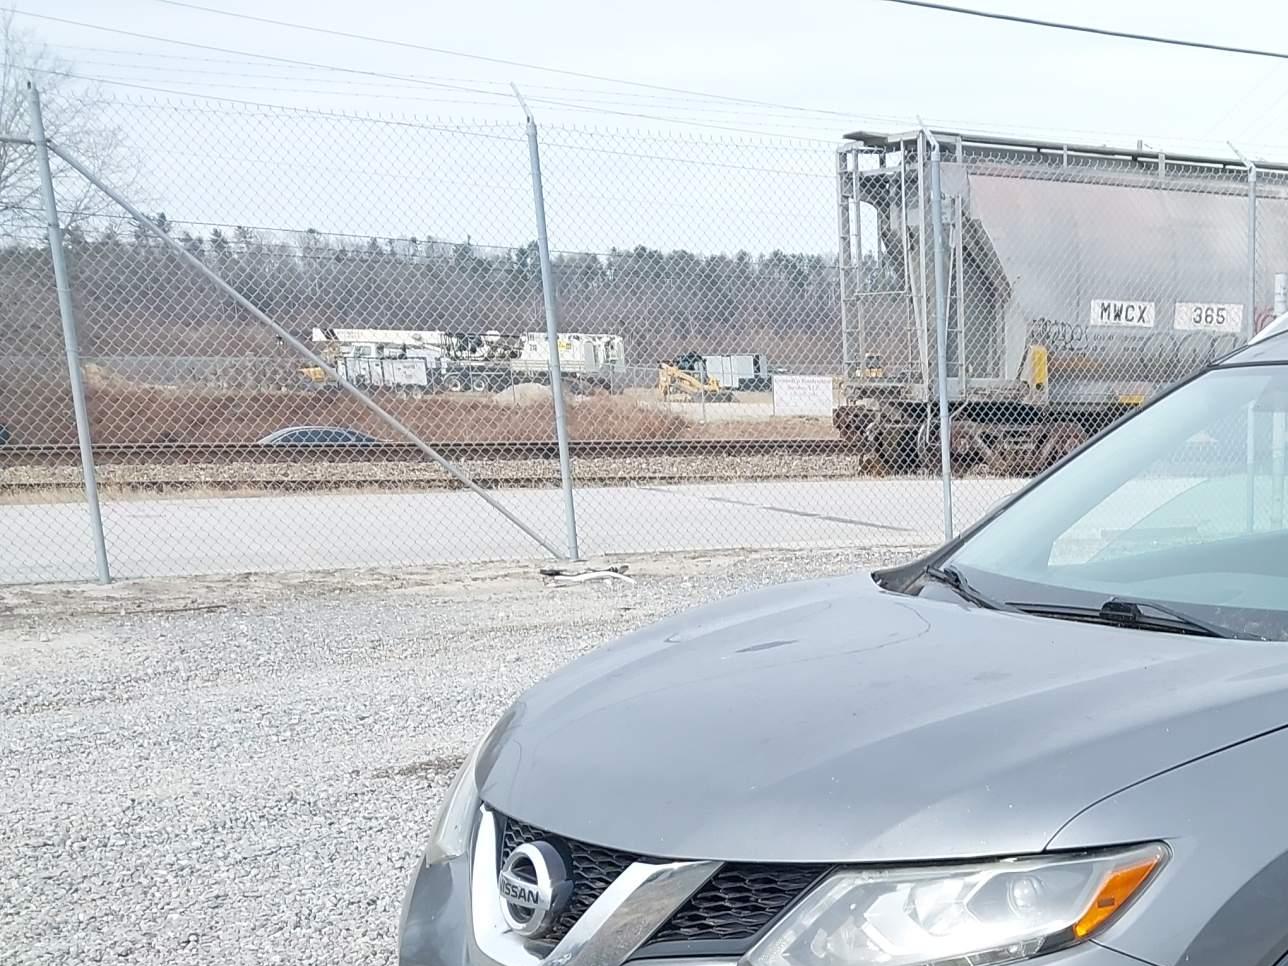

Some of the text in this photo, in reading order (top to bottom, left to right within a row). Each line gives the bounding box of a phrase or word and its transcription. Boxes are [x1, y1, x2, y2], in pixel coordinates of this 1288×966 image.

[1100, 302, 1226, 324] MWCX 365
[500, 877, 539, 904] NISSAN
